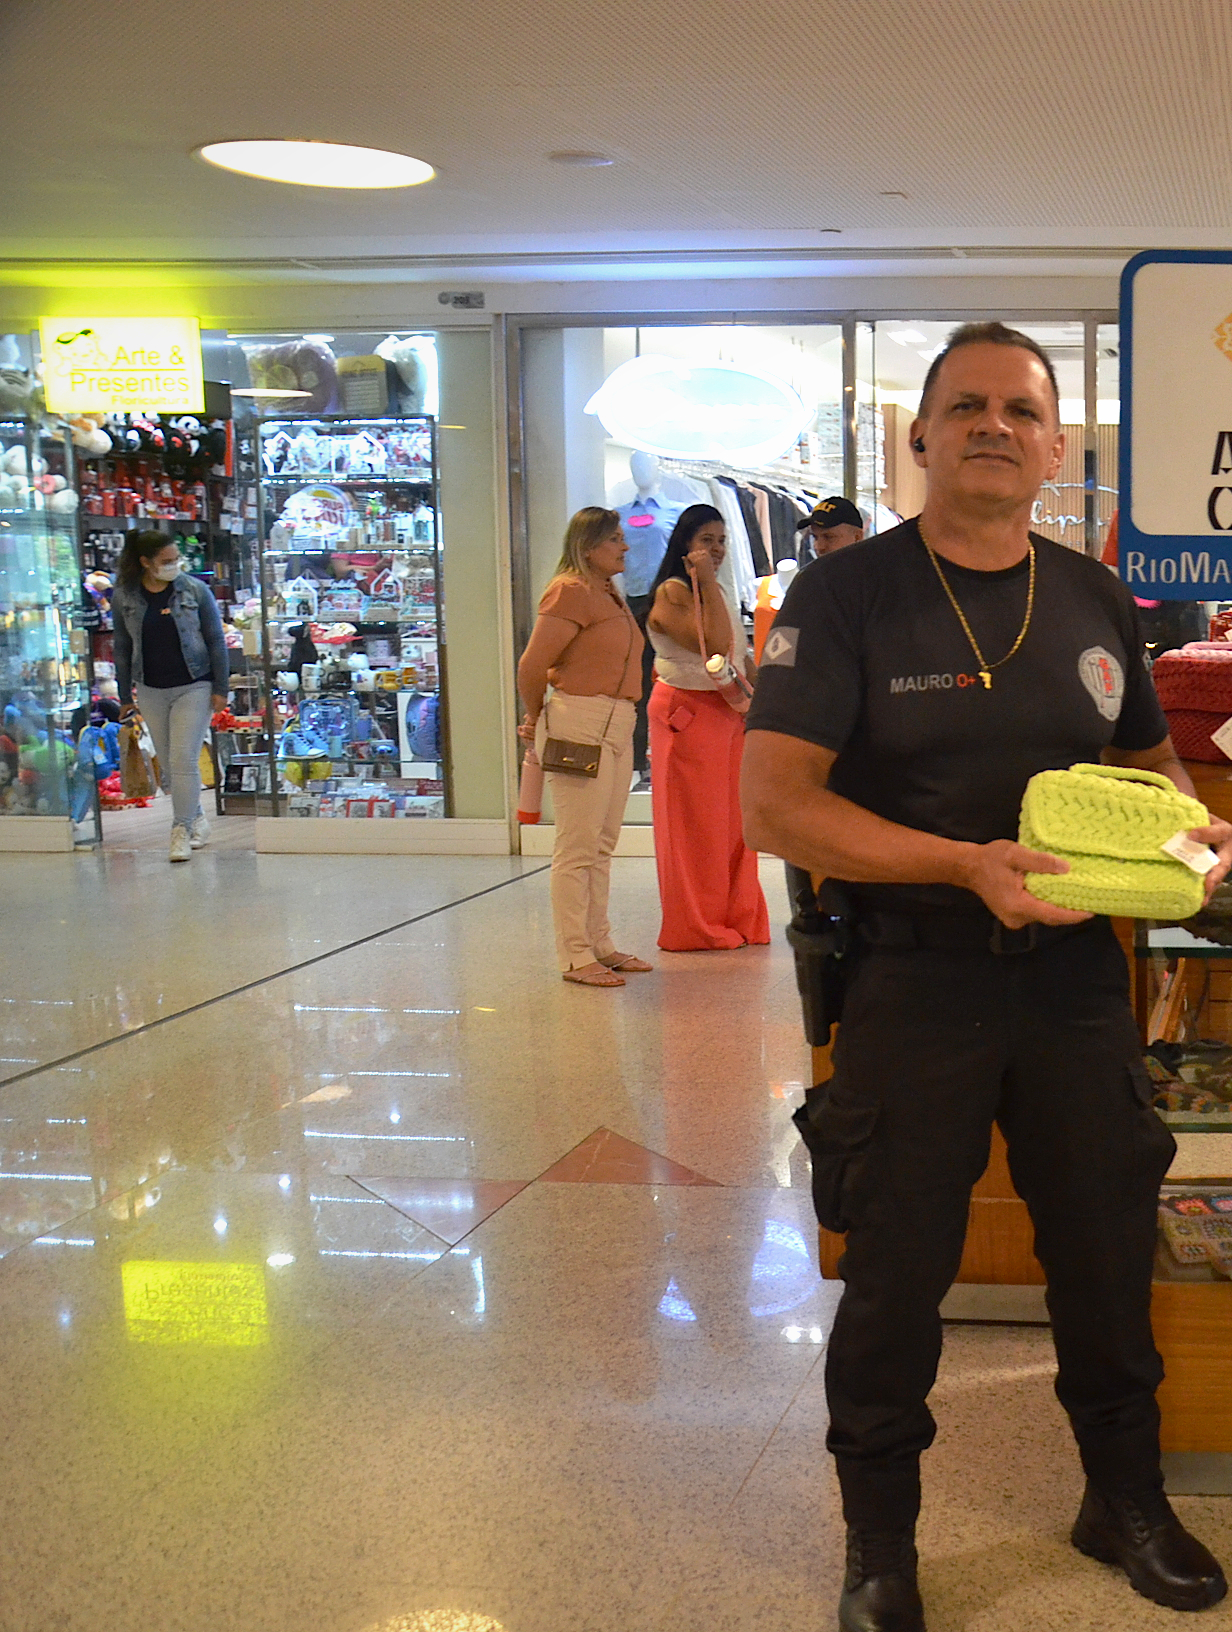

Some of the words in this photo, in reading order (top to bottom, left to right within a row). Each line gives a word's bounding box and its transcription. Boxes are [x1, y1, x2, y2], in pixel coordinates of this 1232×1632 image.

[112, 346, 161, 366] Arte
[169, 345, 186, 365] &
[71, 372, 190, 393] Presentes
[890, 673, 953, 694] MAURO
